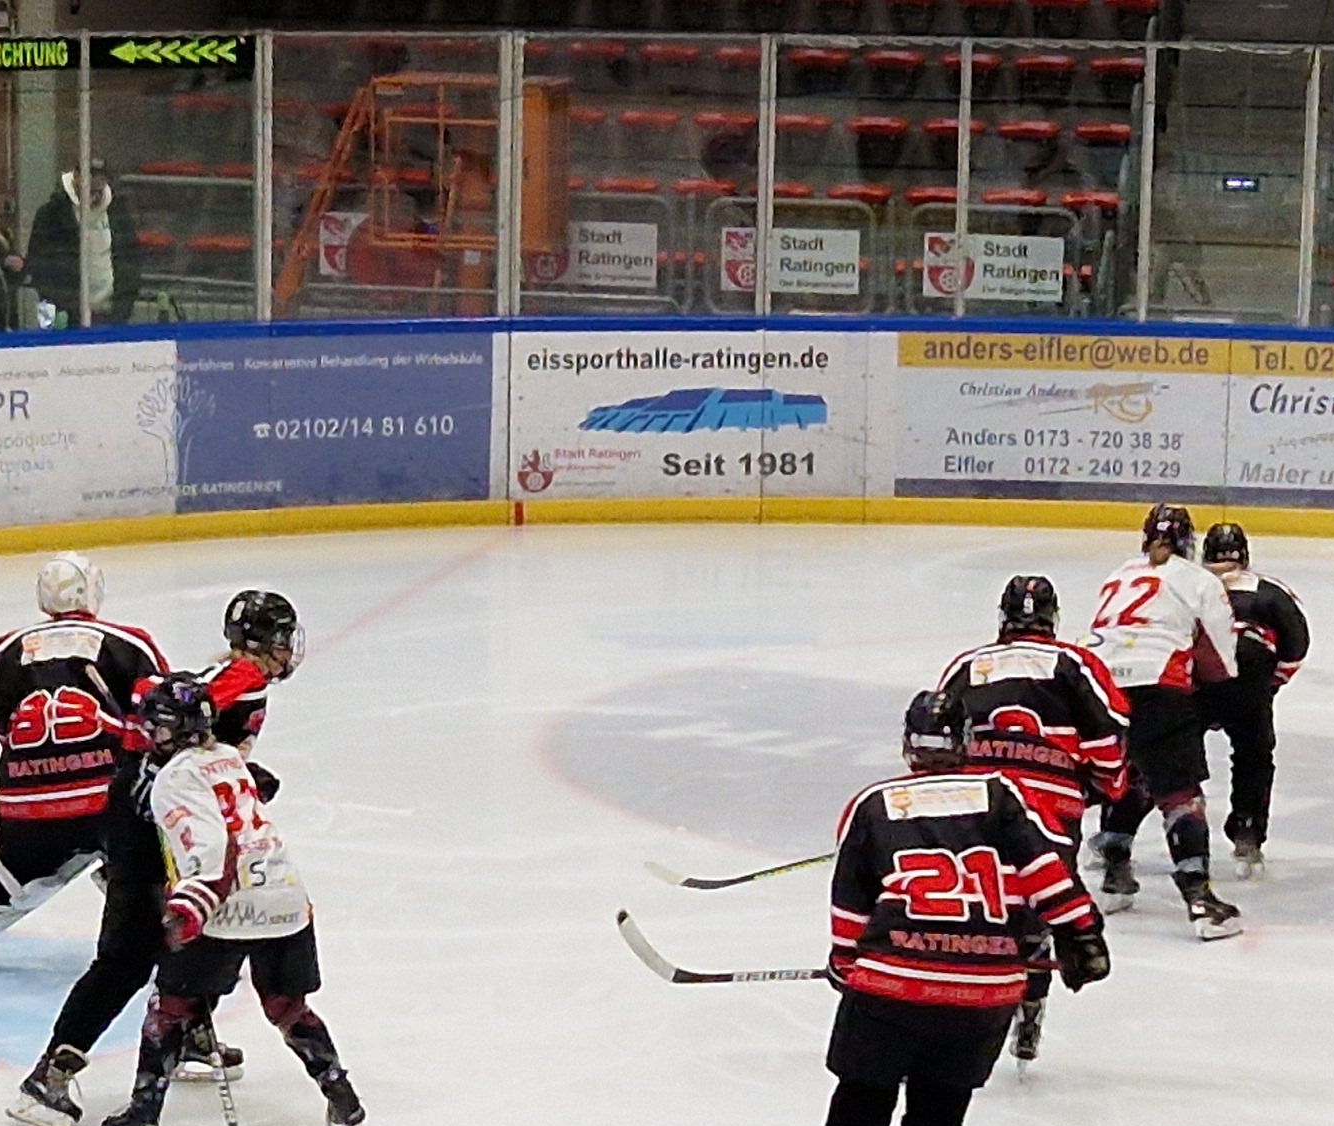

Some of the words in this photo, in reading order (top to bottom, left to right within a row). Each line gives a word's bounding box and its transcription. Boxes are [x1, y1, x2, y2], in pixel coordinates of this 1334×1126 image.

[578, 229, 623, 245] Stadt
[779, 235, 825, 251] Stadt
[983, 240, 1029, 258] Stadt
[578, 251, 654, 270] Ratingen
[779, 257, 856, 277] Ratingen
[982, 263, 1060, 283] Ratingen
[527, 346, 829, 376] eissporthalle-ratingen.de
[923, 337, 1210, 369] anders-eifler@web.de
[1250, 345, 1291, 372] Tel.
[274, 415, 374, 440] 02102/14
[381, 416, 406, 437] 81
[414, 414, 455, 436] 610
[945, 427, 1018, 448] Anders
[1024, 428, 1070, 449] 0173
[1090, 430, 1124, 450] 720
[1130, 430, 1153, 451] 38
[1158, 431, 1183, 451] 38
[662, 451, 725, 477] Seit
[738, 451, 817, 477] 1981
[943, 455, 996, 475] Eifler
[1024, 456, 1070, 476] 0172
[1089, 458, 1124, 478] 240
[1131, 459, 1152, 478] 12
[1158, 459, 1182, 480] 29
[1239, 461, 1313, 486] Maler
[1091, 575, 1162, 629] 22
[893, 845, 1009, 925] 21
[888, 929, 1019, 956] RATINGEN
